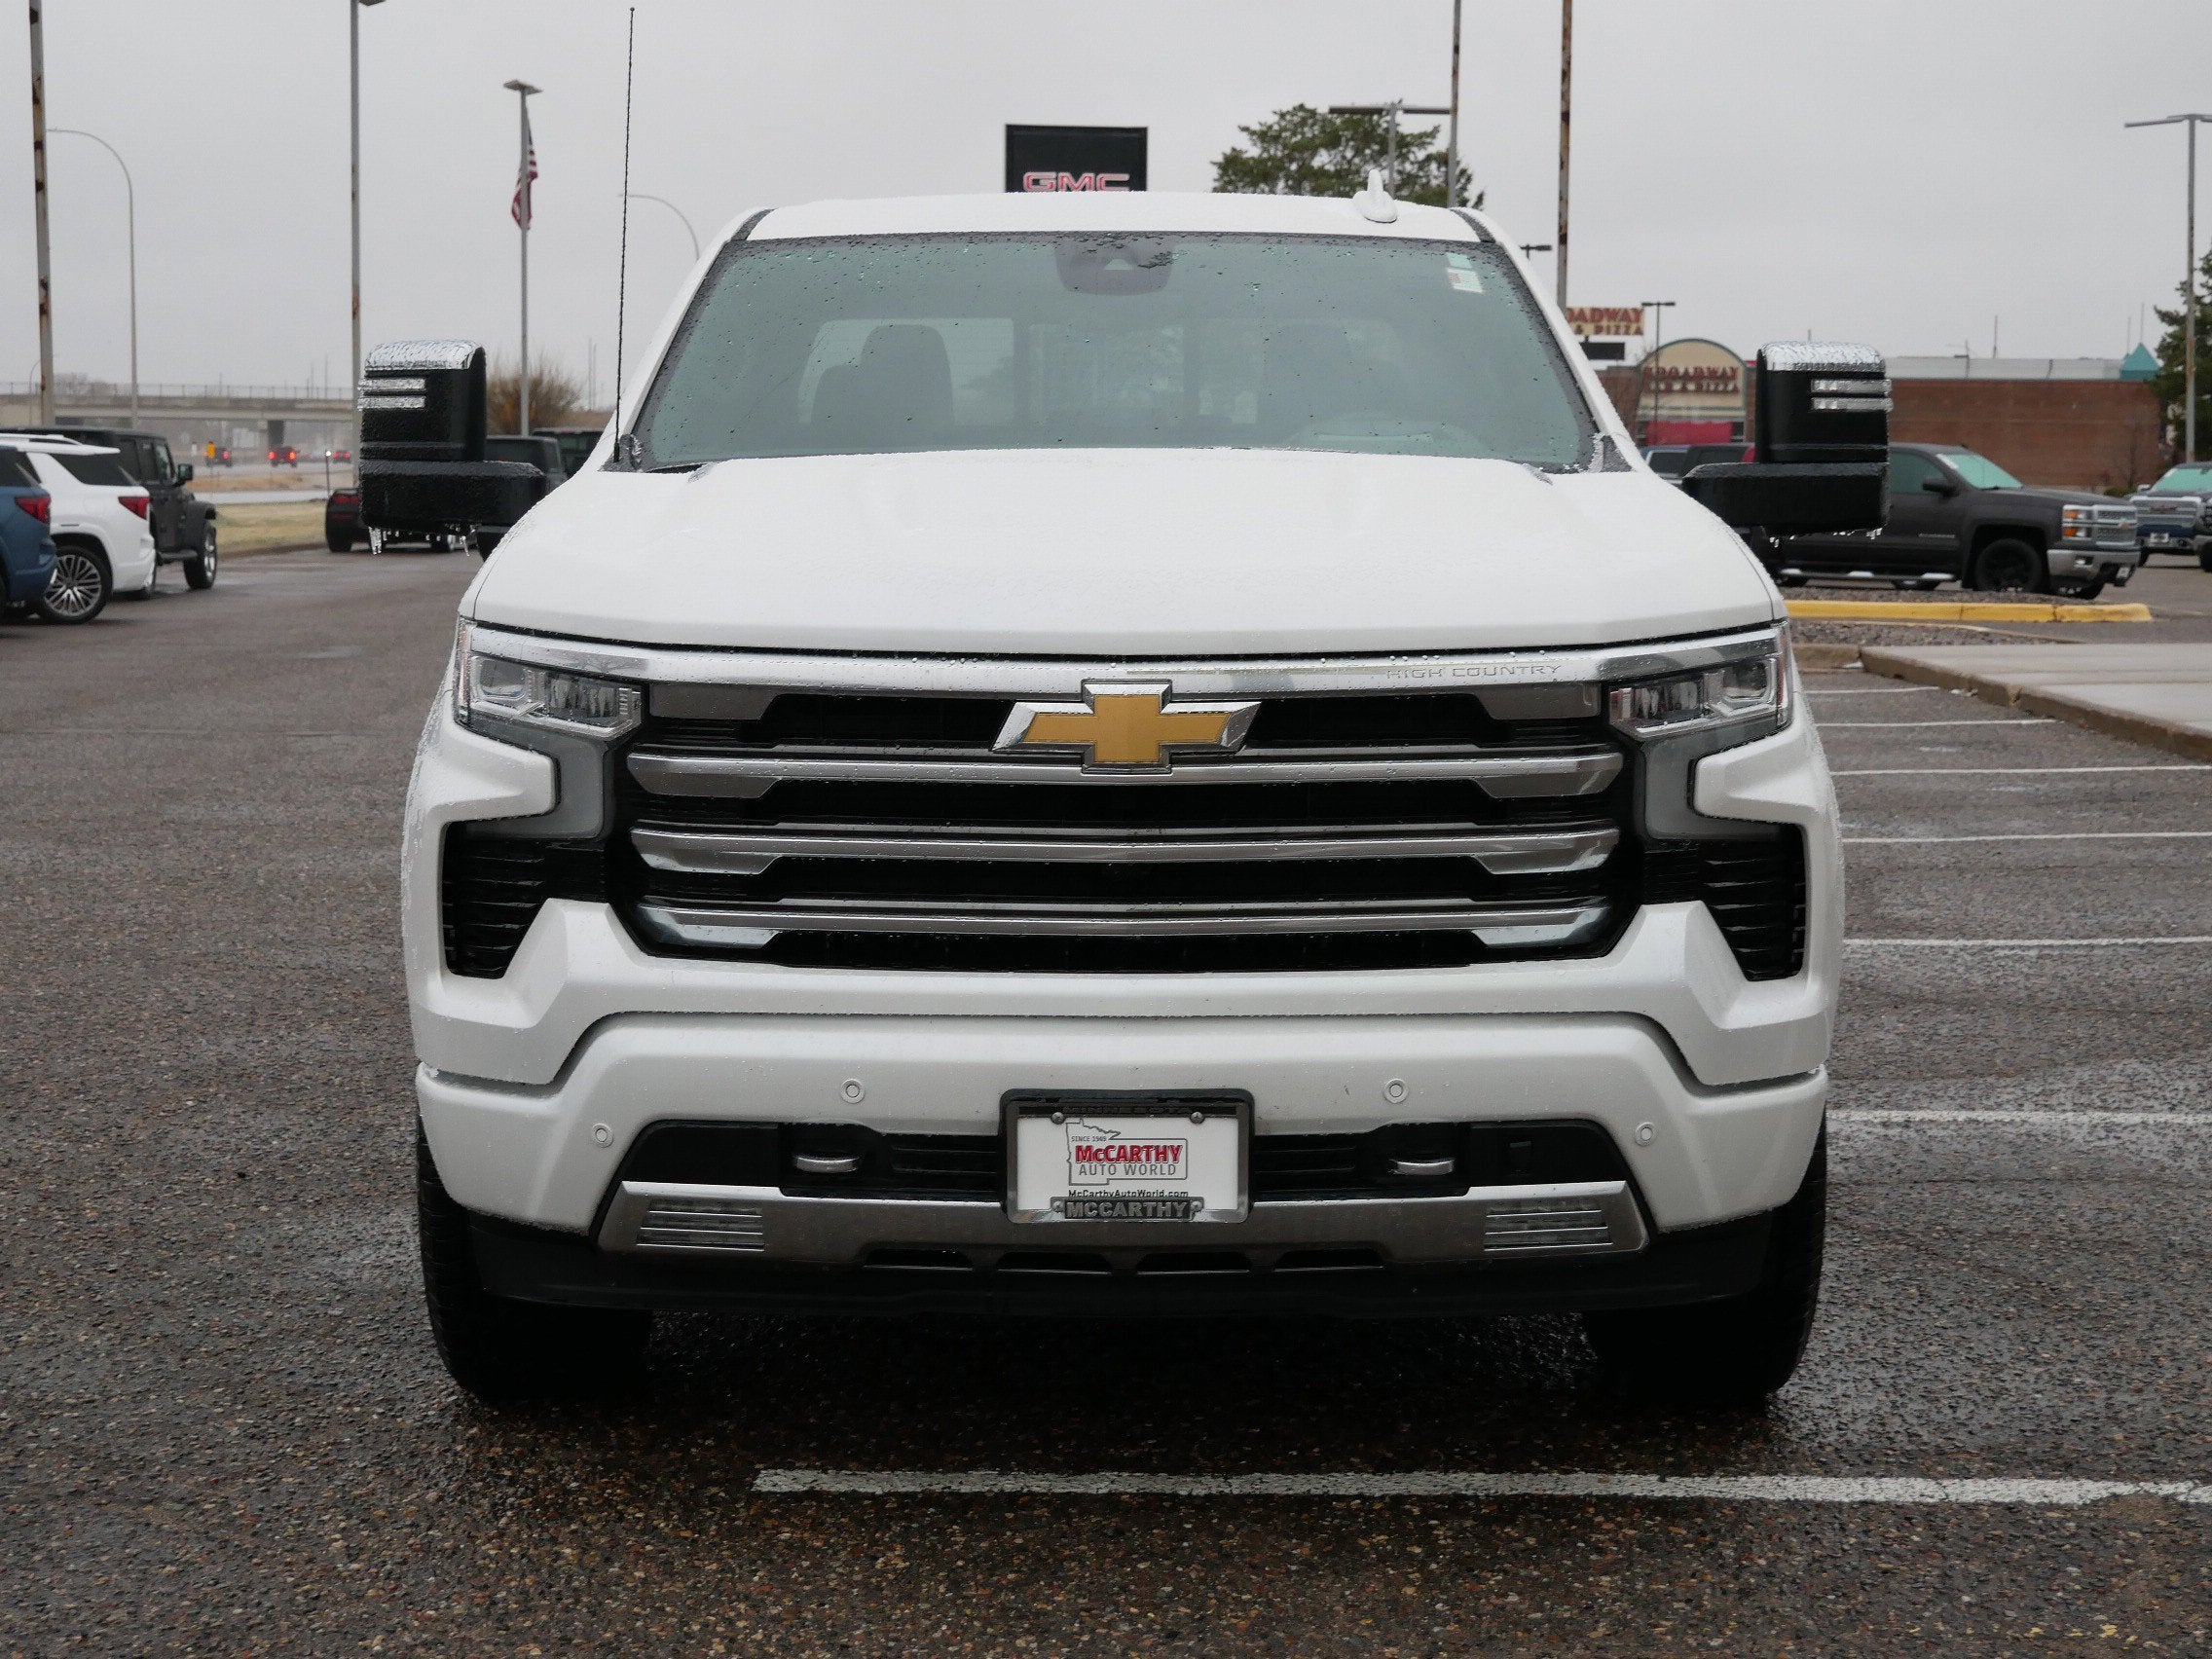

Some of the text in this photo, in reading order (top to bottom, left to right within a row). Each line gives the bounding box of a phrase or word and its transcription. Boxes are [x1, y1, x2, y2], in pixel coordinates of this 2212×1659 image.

[1023, 171, 1130, 192] GMC
[1594, 324, 1643, 335] PIZZA
[1642, 366, 1738, 380] BROADWAY
[1387, 665, 1562, 680] HIGH COUNTRY
[1075, 1145, 1183, 1163] McCARTHY
[1079, 1163, 1176, 1176] AUTO WORLD
[1068, 1189, 1189, 1198] McCarthyAutoWorld.com
[1066, 1201, 1188, 1218] MCCARTHY
